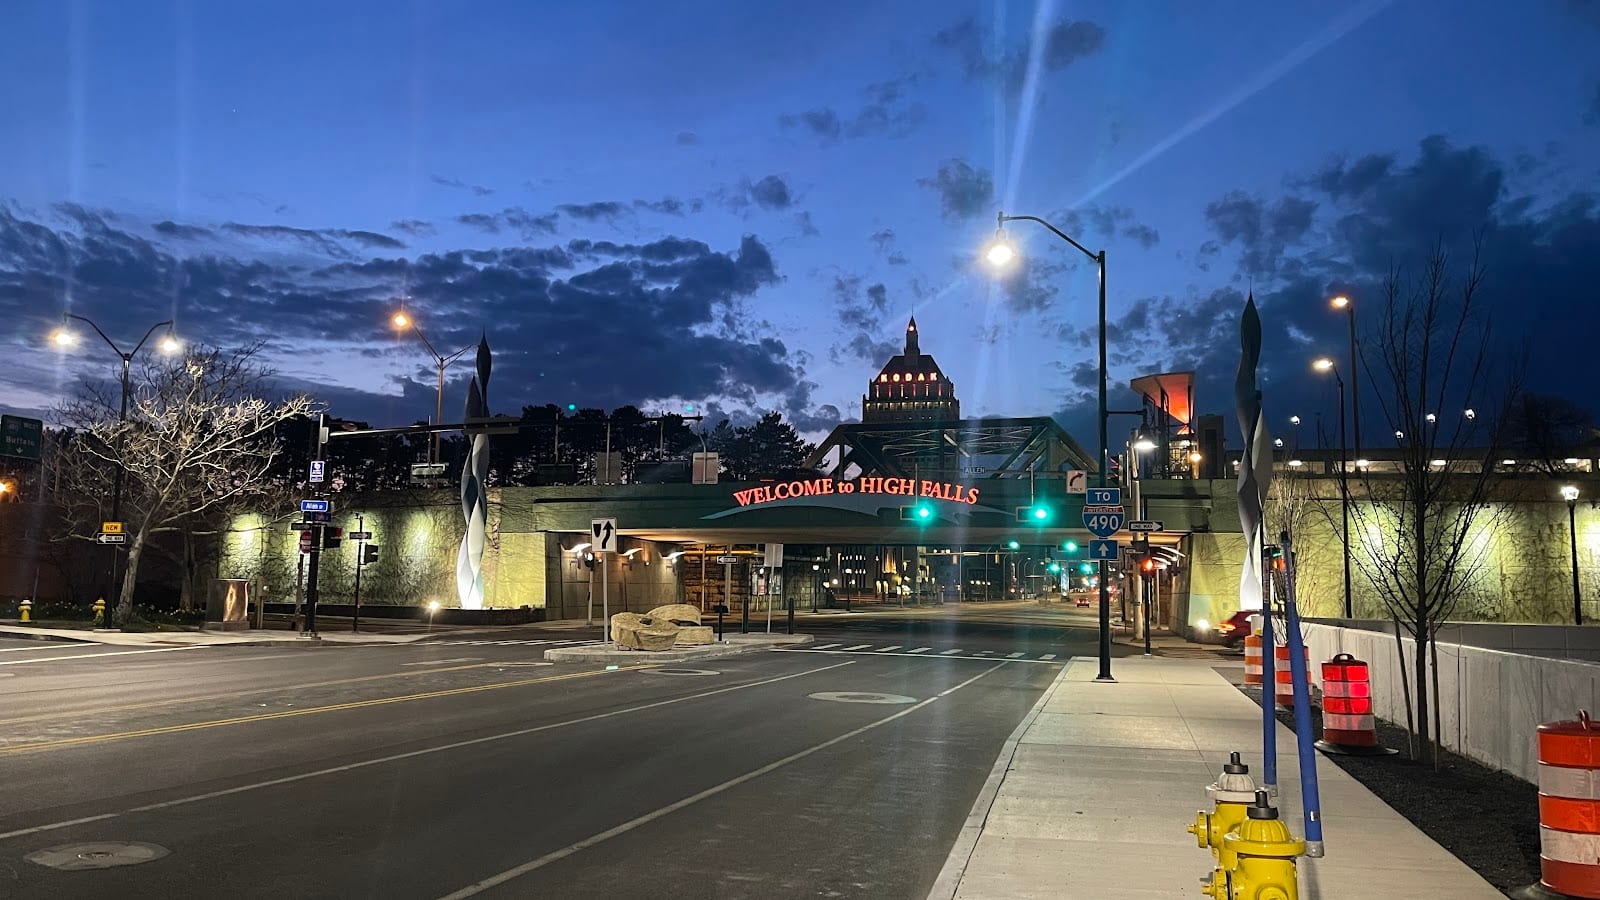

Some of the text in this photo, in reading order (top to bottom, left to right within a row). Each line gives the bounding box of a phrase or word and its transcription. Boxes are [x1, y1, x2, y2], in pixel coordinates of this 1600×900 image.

[880, 372, 937, 383] KODAK
[733, 477, 980, 507] WELCOME to HIGH FALLS
[1094, 491, 1111, 502] TO
[1088, 515, 1119, 531] 490
